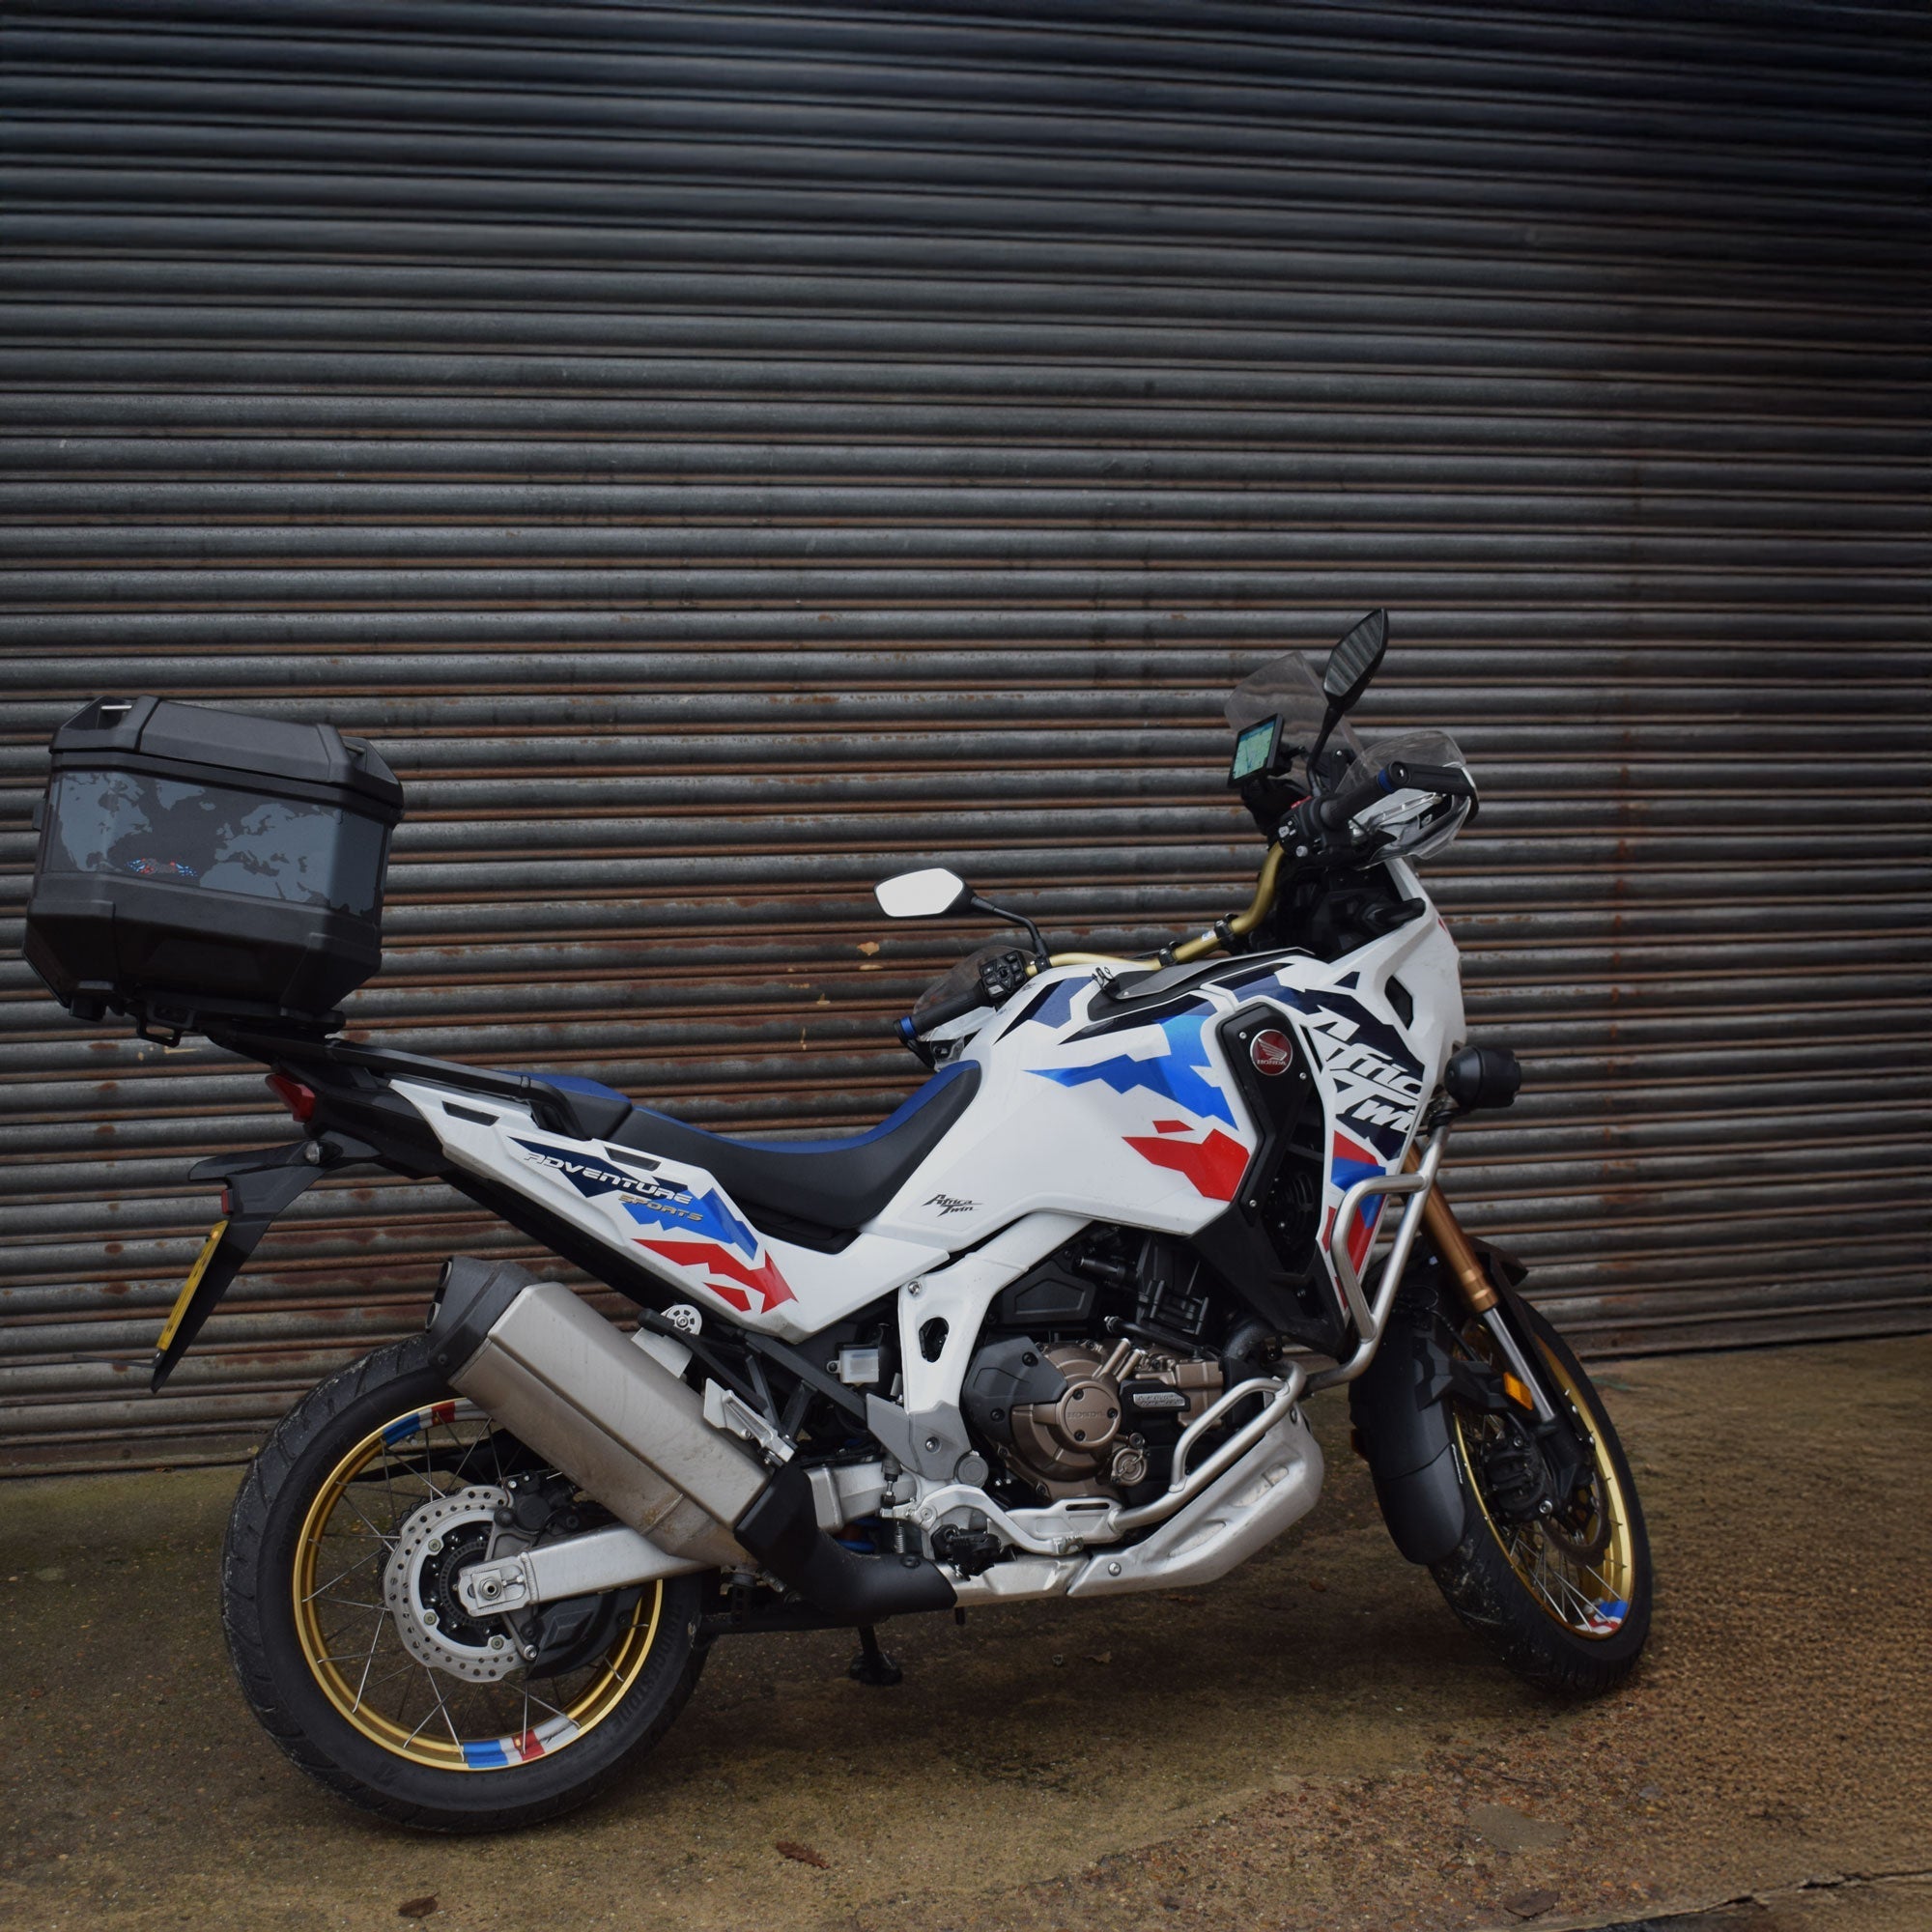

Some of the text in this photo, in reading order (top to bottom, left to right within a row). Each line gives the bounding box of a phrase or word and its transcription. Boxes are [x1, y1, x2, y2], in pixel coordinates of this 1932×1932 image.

[524, 1152, 693, 1205] ADVENTURE
[617, 1194, 704, 1222] SPORTS
[922, 1194, 978, 1207] Africa
[937, 1205, 976, 1217] Twin
